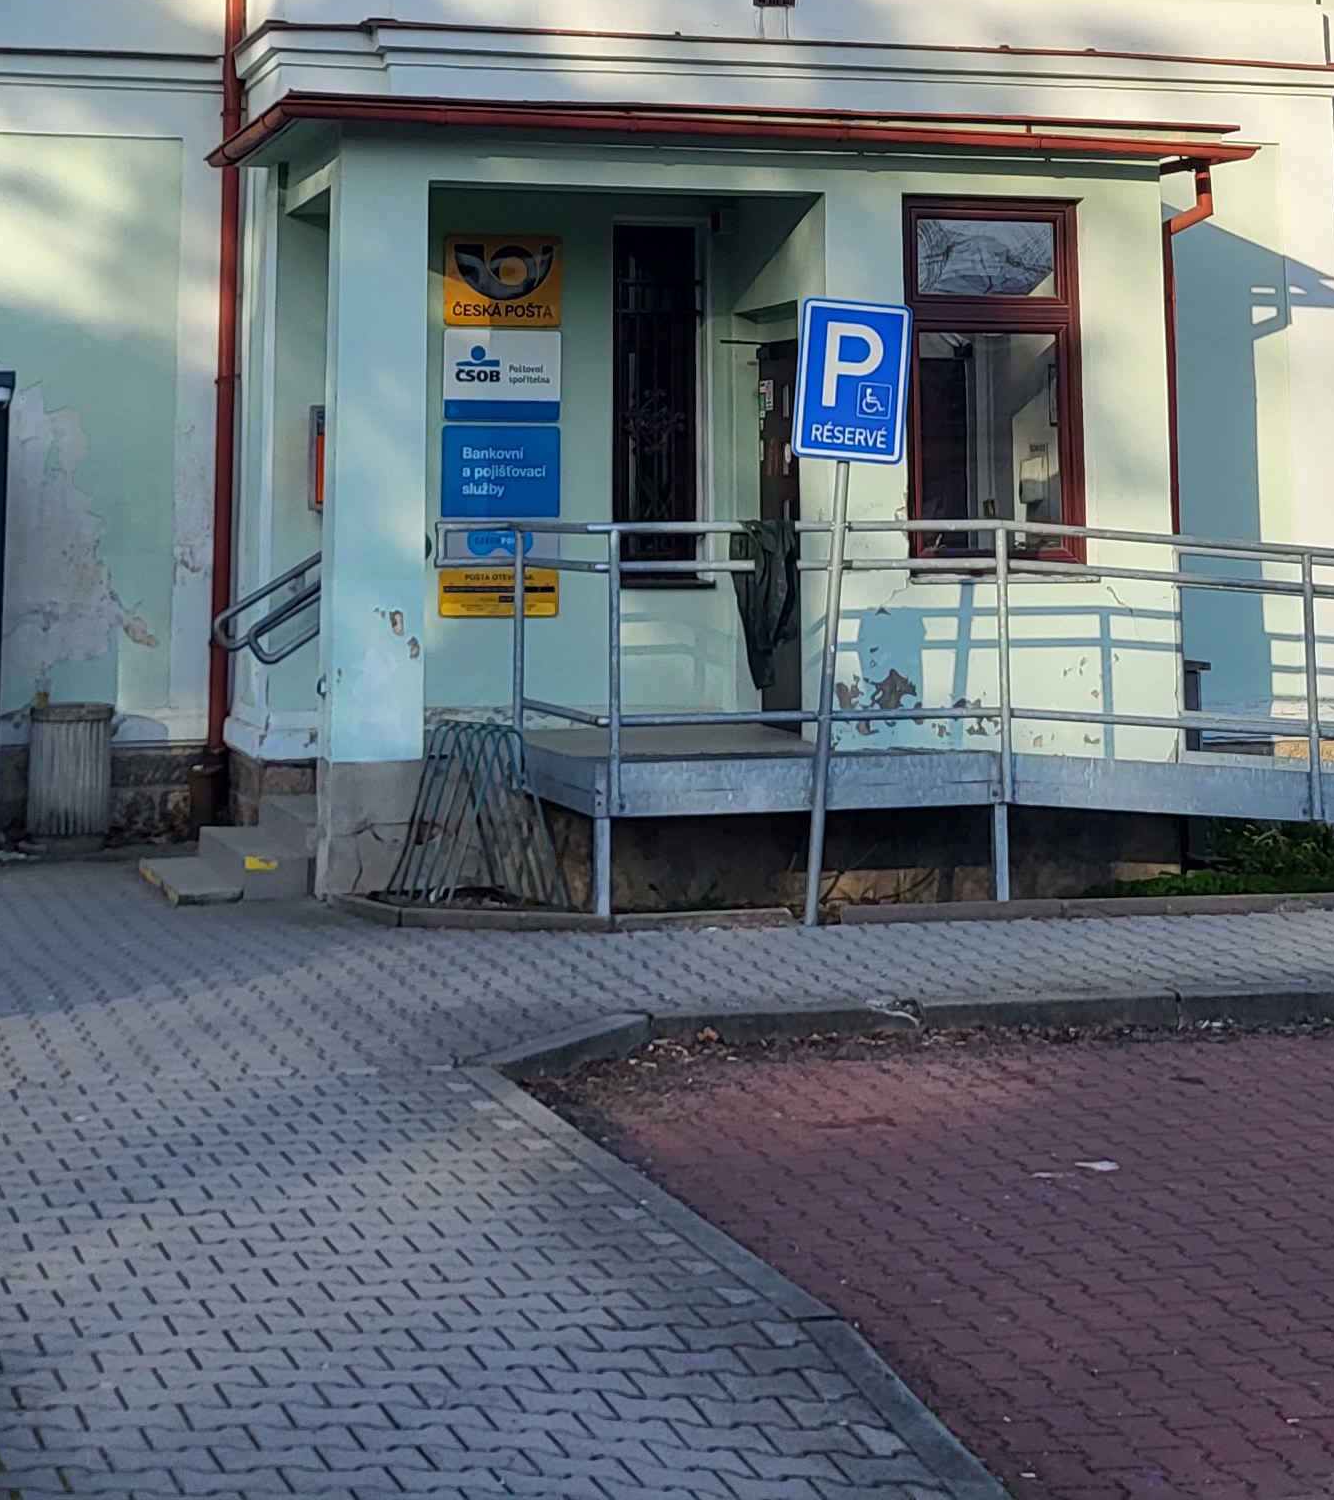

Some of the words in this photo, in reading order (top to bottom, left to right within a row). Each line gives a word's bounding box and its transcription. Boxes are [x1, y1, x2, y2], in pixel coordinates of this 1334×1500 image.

[452, 301, 502, 317] ČESKÁ
[505, 302, 553, 319] POŠTA
[822, 321, 884, 407] P
[455, 367, 501, 383] ČSOB
[811, 421, 887, 449] RÉSERVÉ
[462, 446, 525, 460] Bankovní
[462, 466, 471, 478] a
[474, 464, 547, 481] pojišťovací
[462, 482, 505, 498] služby
